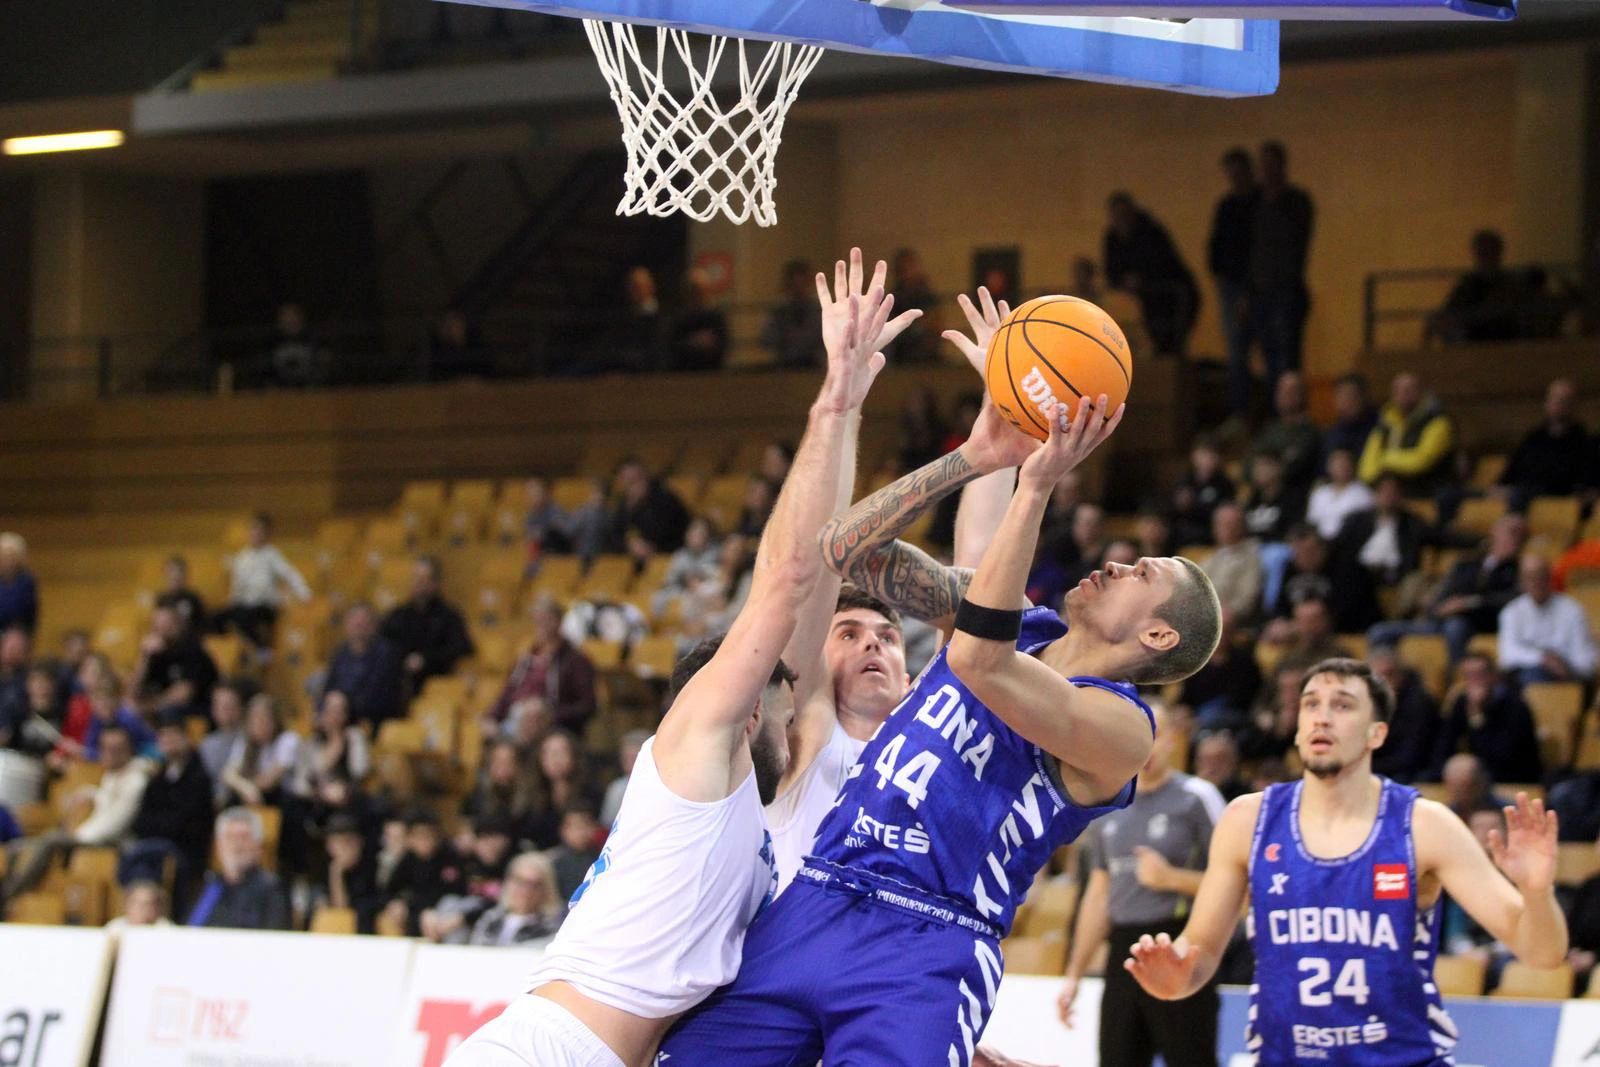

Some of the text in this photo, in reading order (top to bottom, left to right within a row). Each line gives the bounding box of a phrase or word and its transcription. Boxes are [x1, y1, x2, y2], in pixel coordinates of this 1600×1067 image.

[873, 733, 942, 810] 44
[1268, 907, 1399, 951] CIBONA
[1297, 956, 1370, 1007] 24
[1292, 1023, 1361, 1047] ERSTE
